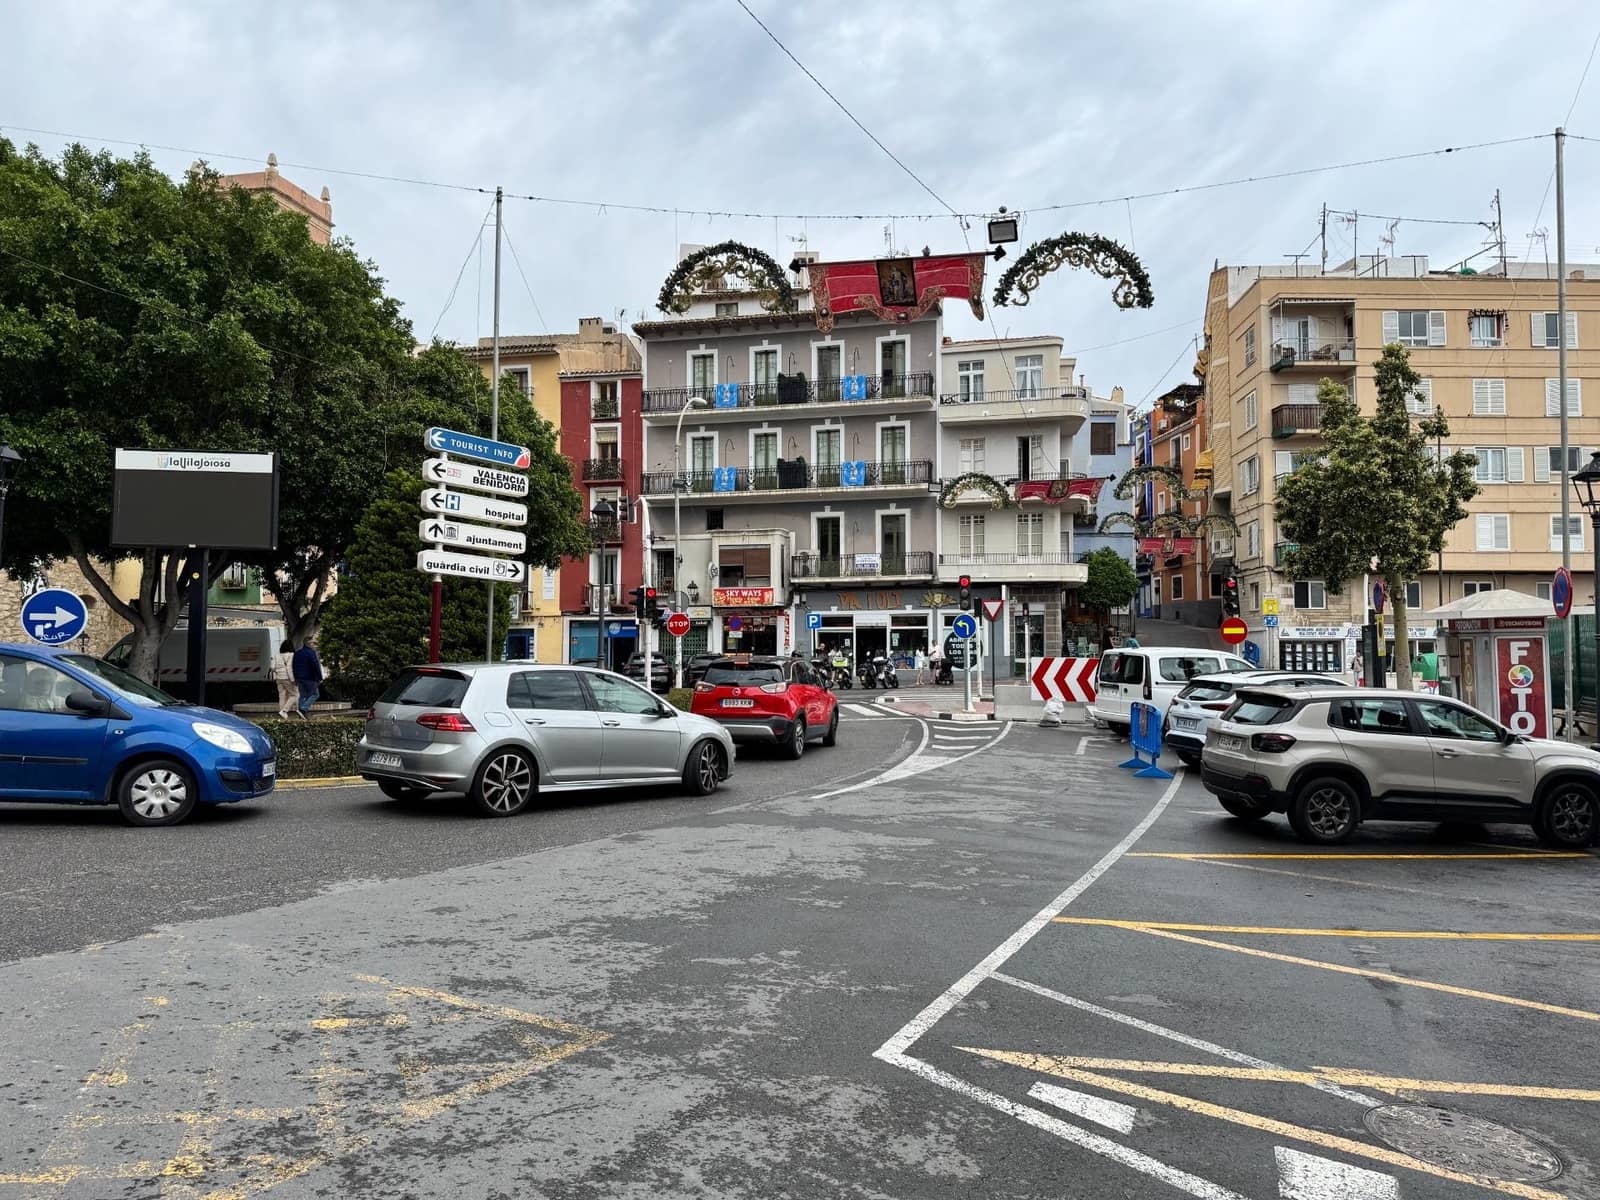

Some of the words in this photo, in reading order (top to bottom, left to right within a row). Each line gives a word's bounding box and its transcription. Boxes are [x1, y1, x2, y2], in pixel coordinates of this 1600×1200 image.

[451, 439, 488, 453] TOURIST
[494, 449, 513, 459] INFO
[472, 477, 525, 493] BENIDORM
[478, 470, 526, 485] VALENCIA
[485, 508, 524, 521] hospital
[466, 535, 523, 550] ajuntament
[469, 566, 490, 575] civil
[726, 589, 740, 597] SKY
[741, 589, 762, 597] WAYS
